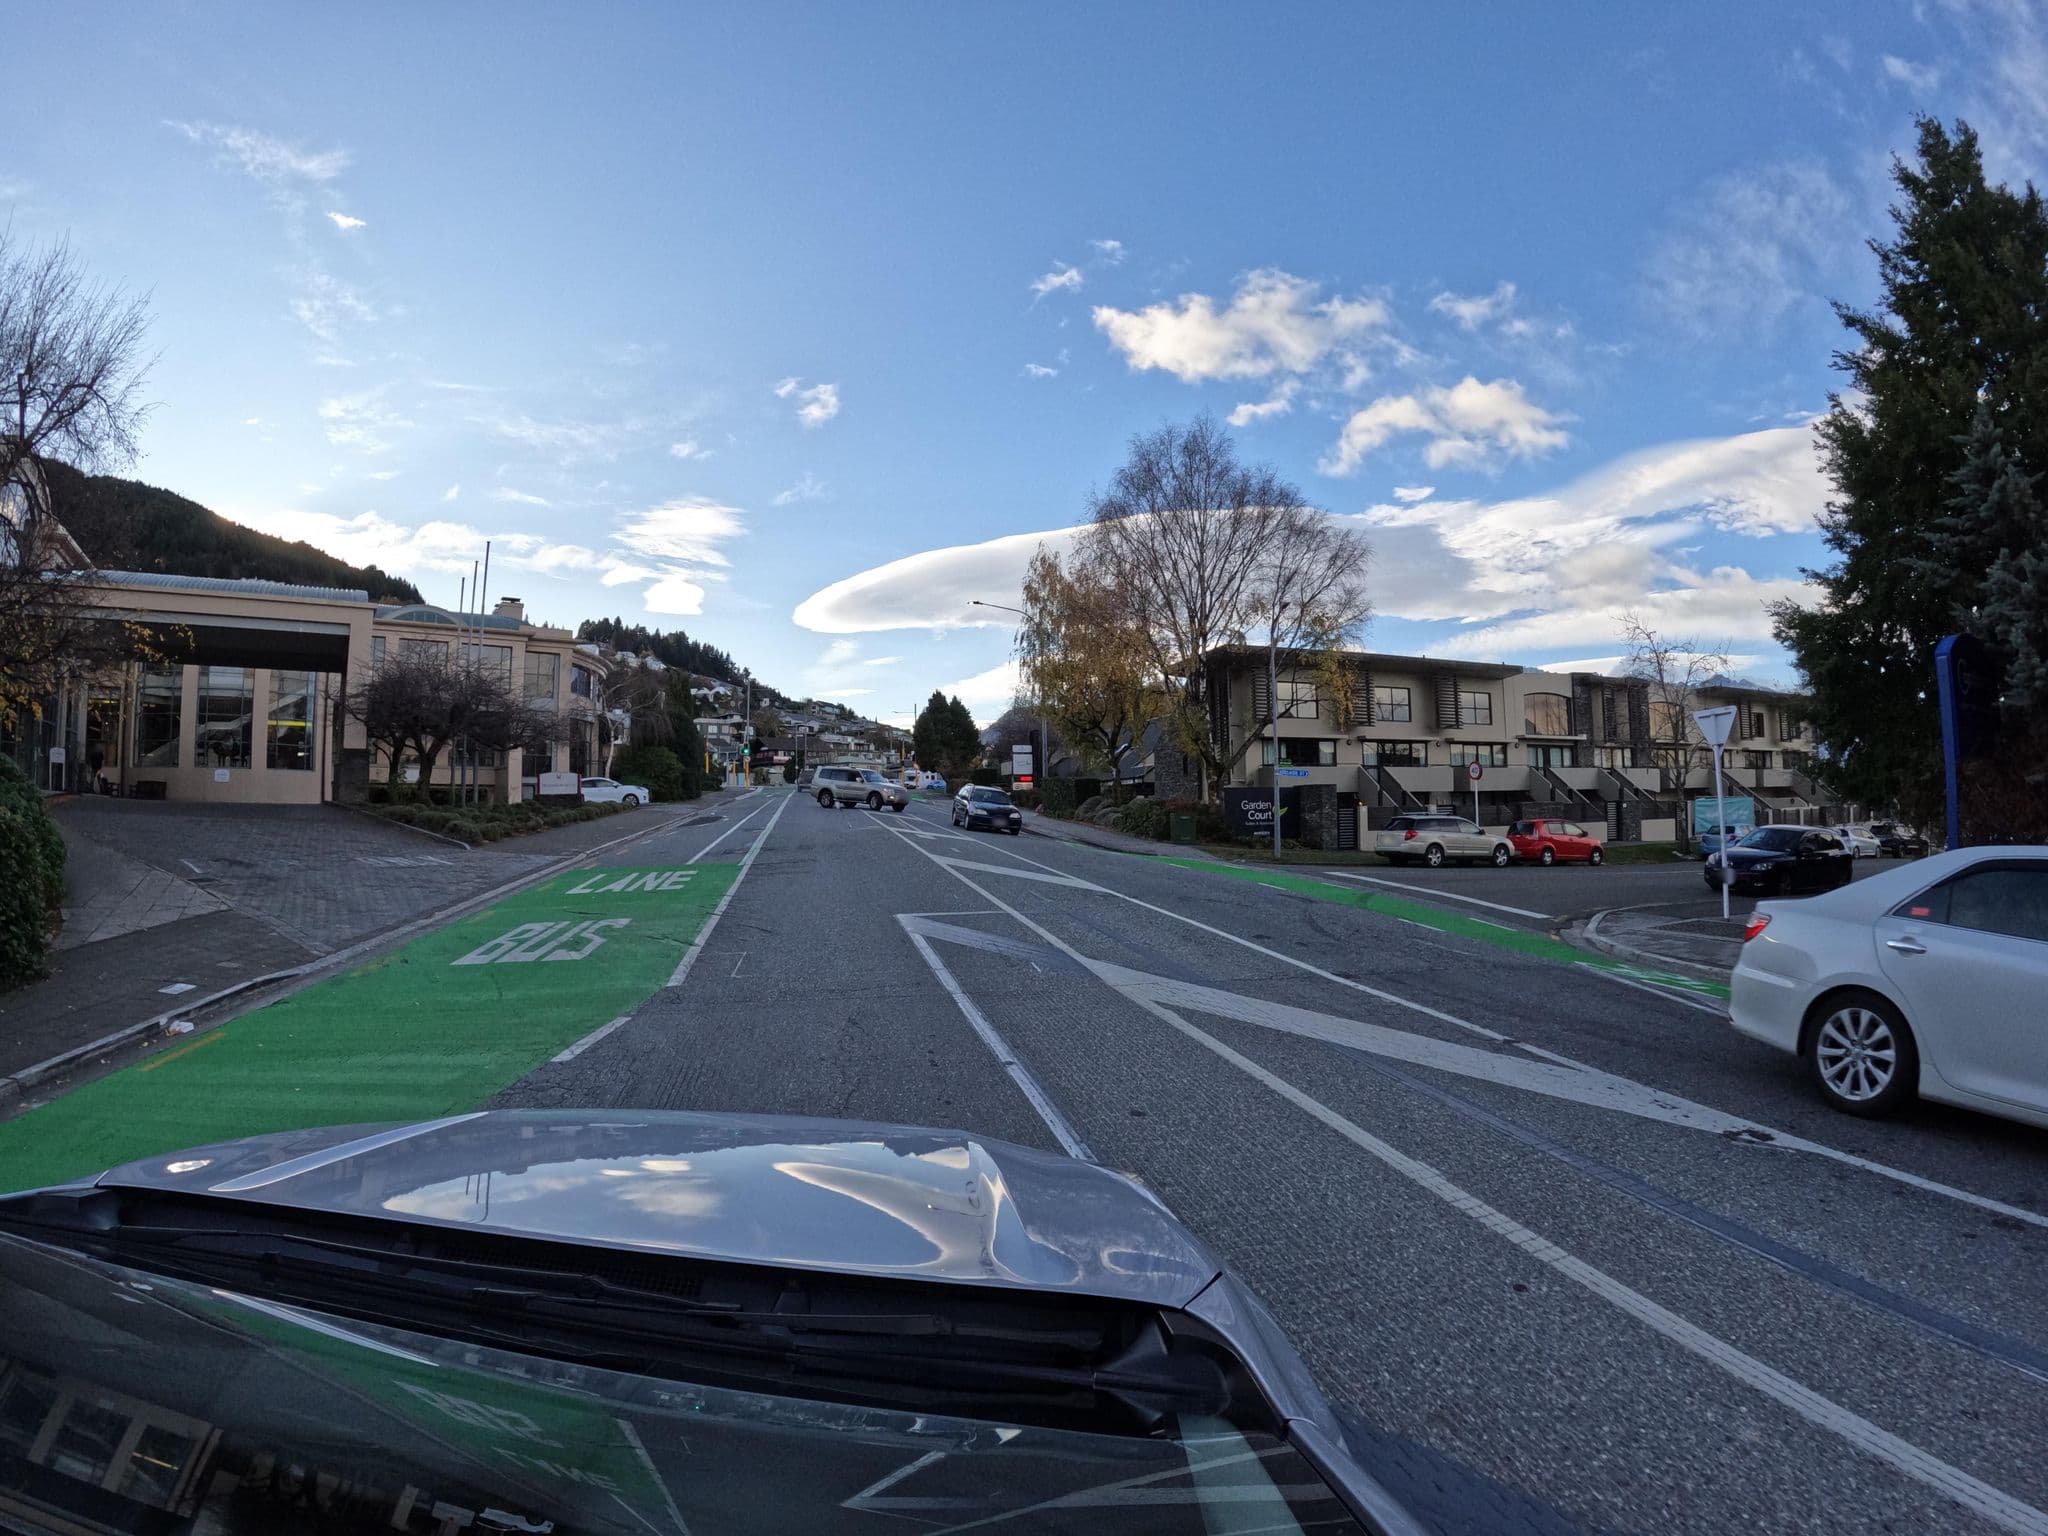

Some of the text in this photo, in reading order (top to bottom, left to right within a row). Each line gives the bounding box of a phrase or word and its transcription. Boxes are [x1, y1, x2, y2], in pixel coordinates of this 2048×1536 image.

[1241, 800, 1272, 810] Garden
[1248, 810, 1273, 820] Court
[565, 870, 697, 895] LANE
[449, 918, 632, 965] BUS
